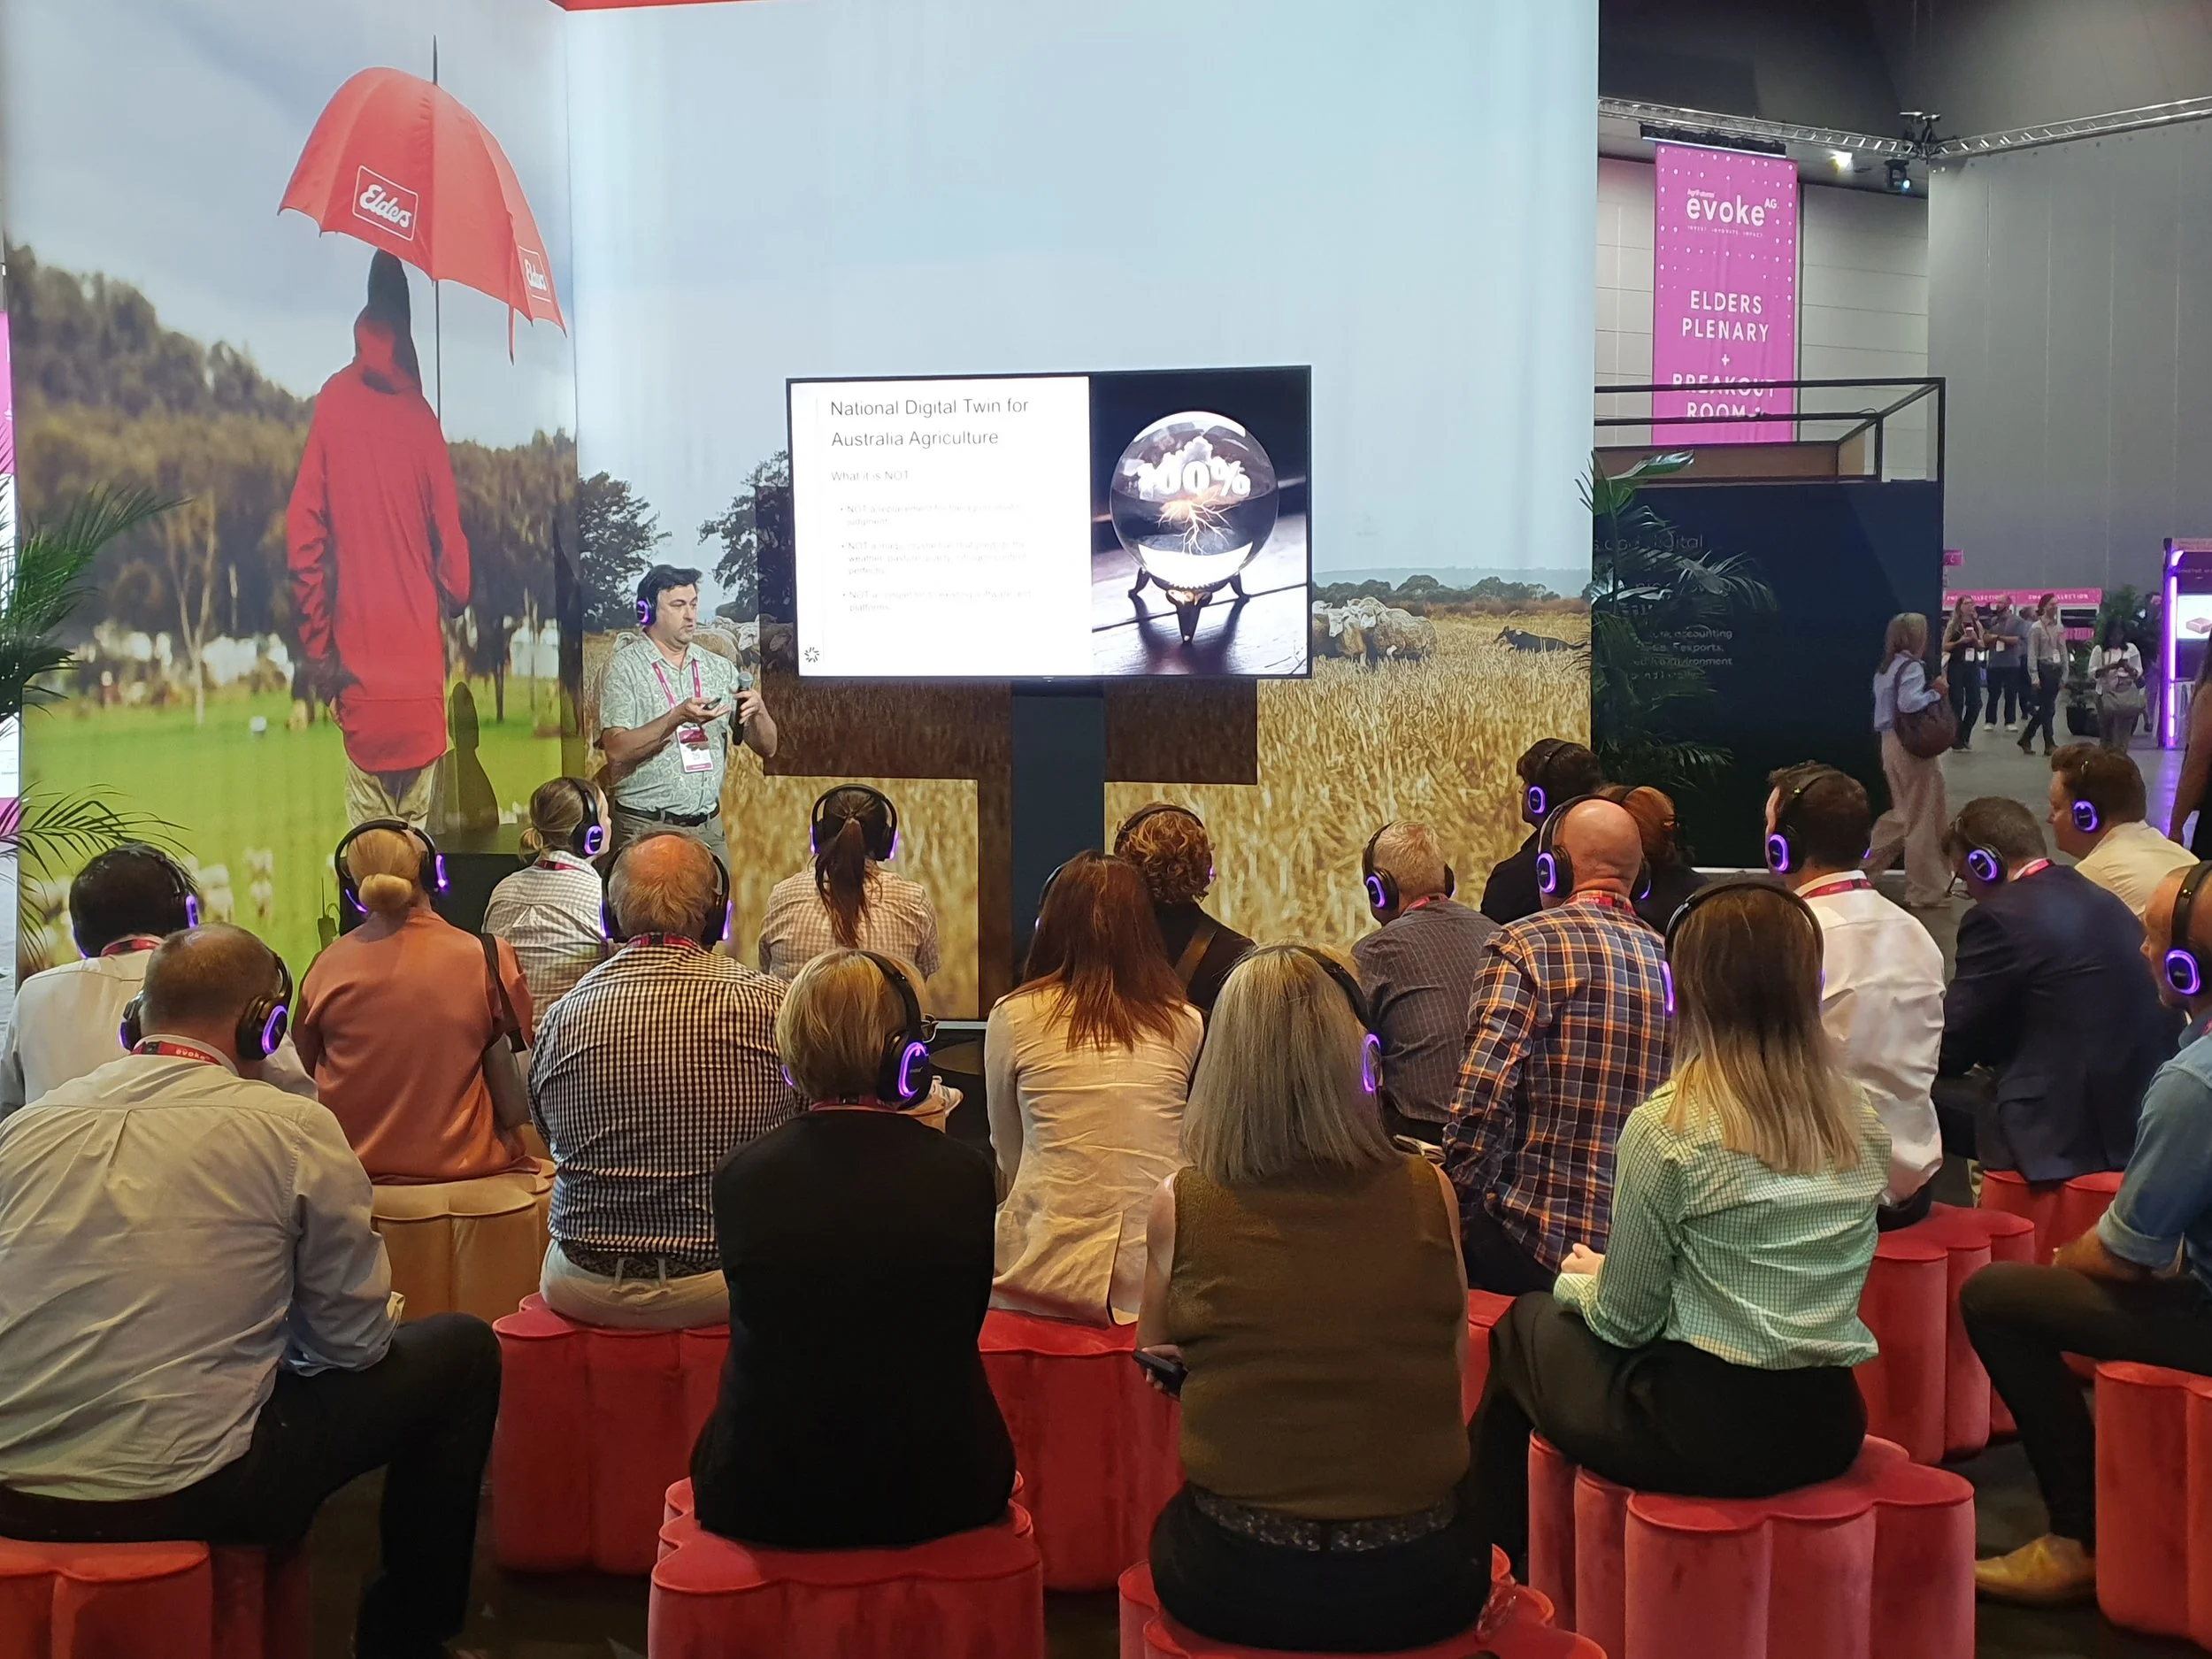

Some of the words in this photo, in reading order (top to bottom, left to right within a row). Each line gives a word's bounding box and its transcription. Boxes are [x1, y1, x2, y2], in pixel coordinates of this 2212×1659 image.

[359, 184, 411, 227] Elders
[1690, 290, 1763, 315] ELDERS
[1682, 317, 1770, 342] PLENARY
[831, 400, 899, 416] National
[905, 399, 956, 419] Digital
[963, 398, 1001, 413] Twin
[1007, 397, 1029, 412] for
[831, 431, 903, 446] Australia
[909, 431, 999, 449] Agriculture
[831, 471, 859, 481] What
[863, 471, 869, 480] it
[872, 471, 881, 480] is
[885, 470, 909, 480] NOT
[1137, 457, 1251, 499] 100%
[176, 1048, 205, 1061] evoke
